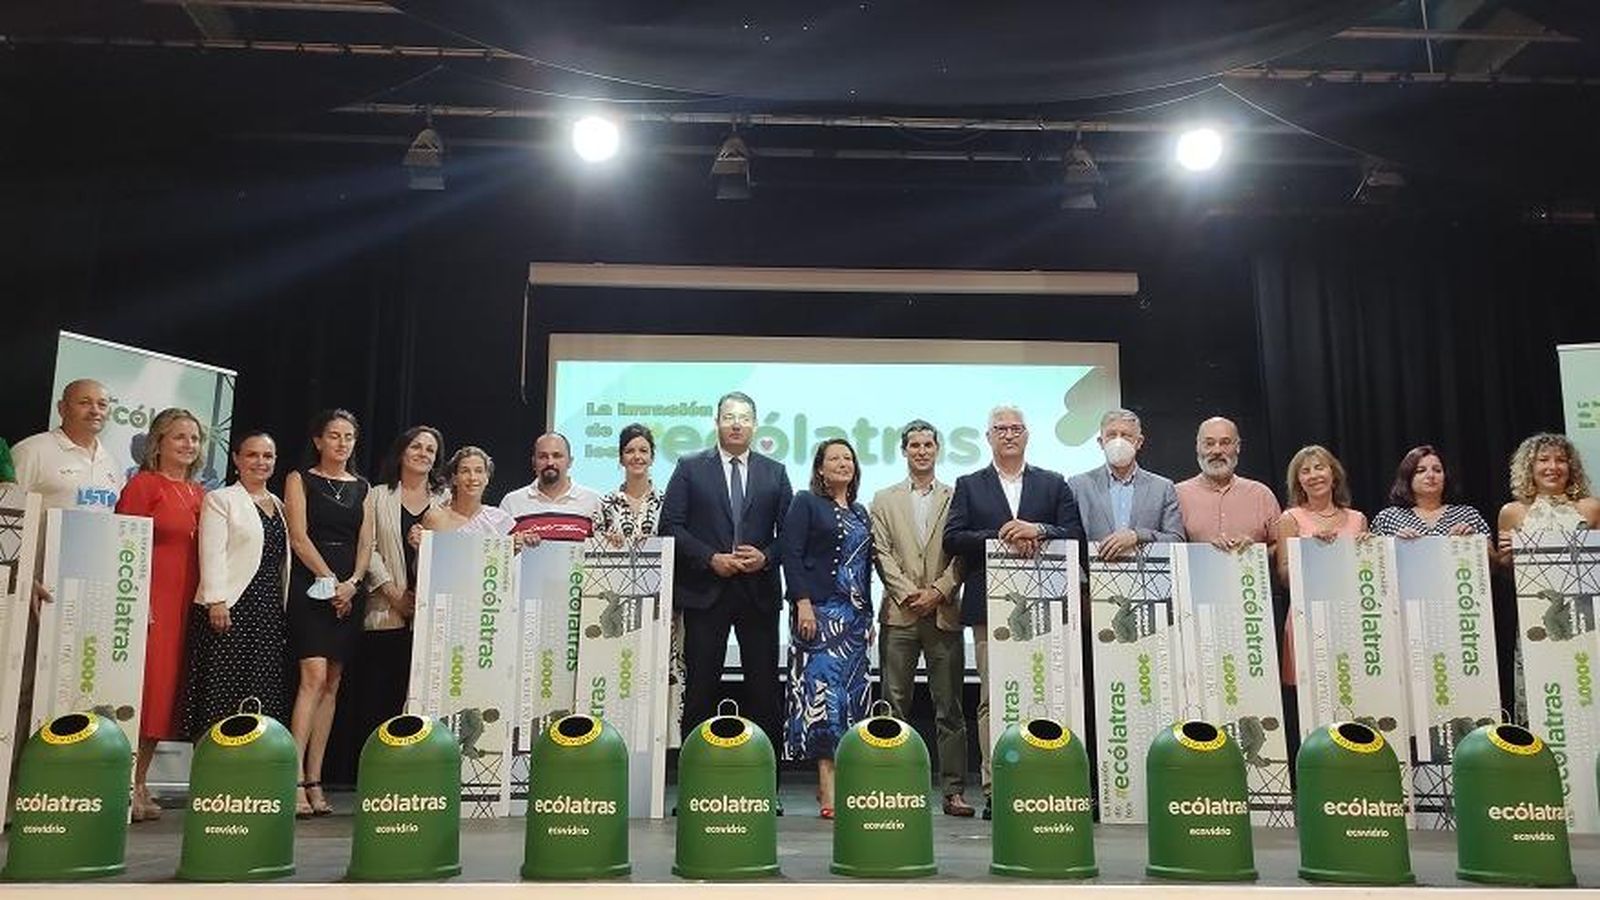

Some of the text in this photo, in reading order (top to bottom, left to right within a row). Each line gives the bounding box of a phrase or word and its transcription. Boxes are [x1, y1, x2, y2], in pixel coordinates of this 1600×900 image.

[661, 411, 982, 466] eólatrs
[112, 549, 140, 662] ecólatras
[478, 565, 502, 669] ecólatras
[1241, 574, 1265, 677] ecólatras
[1359, 569, 1382, 676] ecólatras
[1456, 567, 1481, 677] ecólatras
[1107, 682, 1129, 789] ecólatras
[192, 794, 281, 814] ecólatras
[362, 793, 447, 813] ecólatras
[534, 795, 617, 815] ecólatras
[846, 791, 926, 810] ecólatras
[1488, 801, 1566, 821] ecólatra
